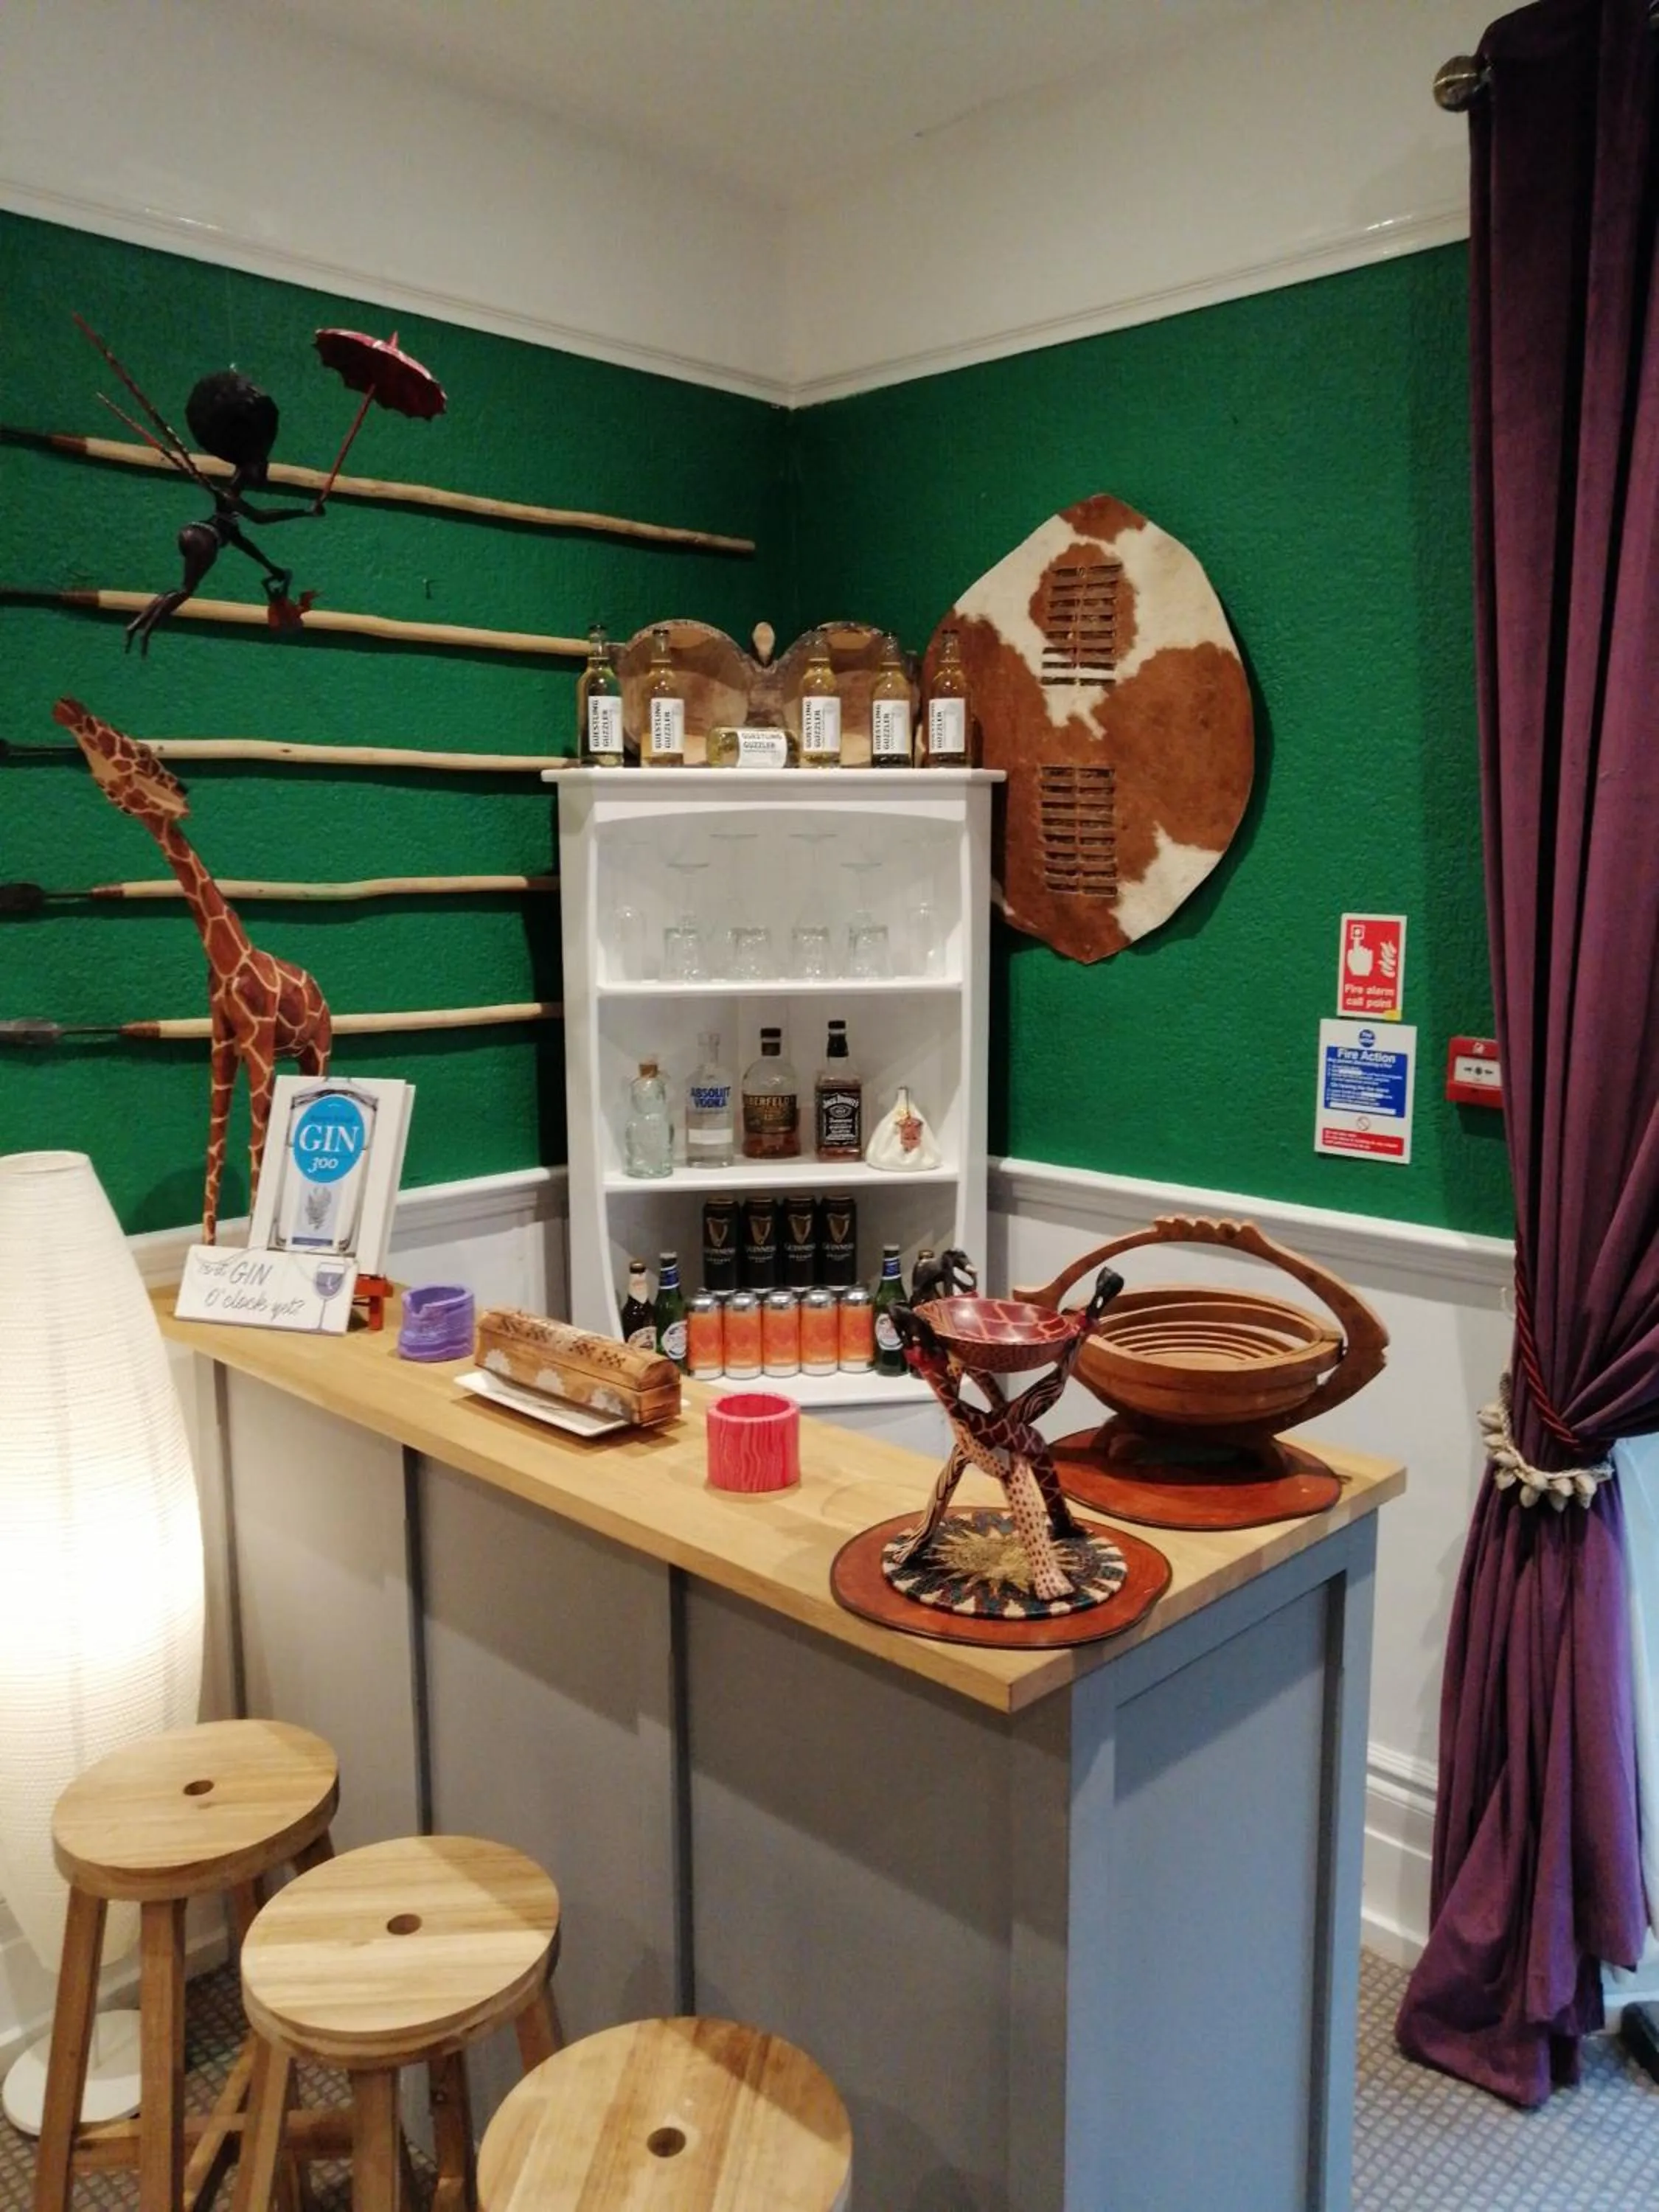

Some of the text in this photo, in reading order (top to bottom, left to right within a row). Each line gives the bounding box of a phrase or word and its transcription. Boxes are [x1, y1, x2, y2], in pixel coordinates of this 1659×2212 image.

[591, 699, 599, 748] GUESTLING
[1344, 984, 1395, 996] Fire alarm
[1346, 997, 1392, 1009] call point
[1337, 1048, 1359, 1060] Fire
[1360, 1050, 1396, 1063] Action
[691, 1086, 731, 1097] ABSOLUT
[299, 1124, 360, 1152] GIN
[229, 1261, 273, 1286] GIN
